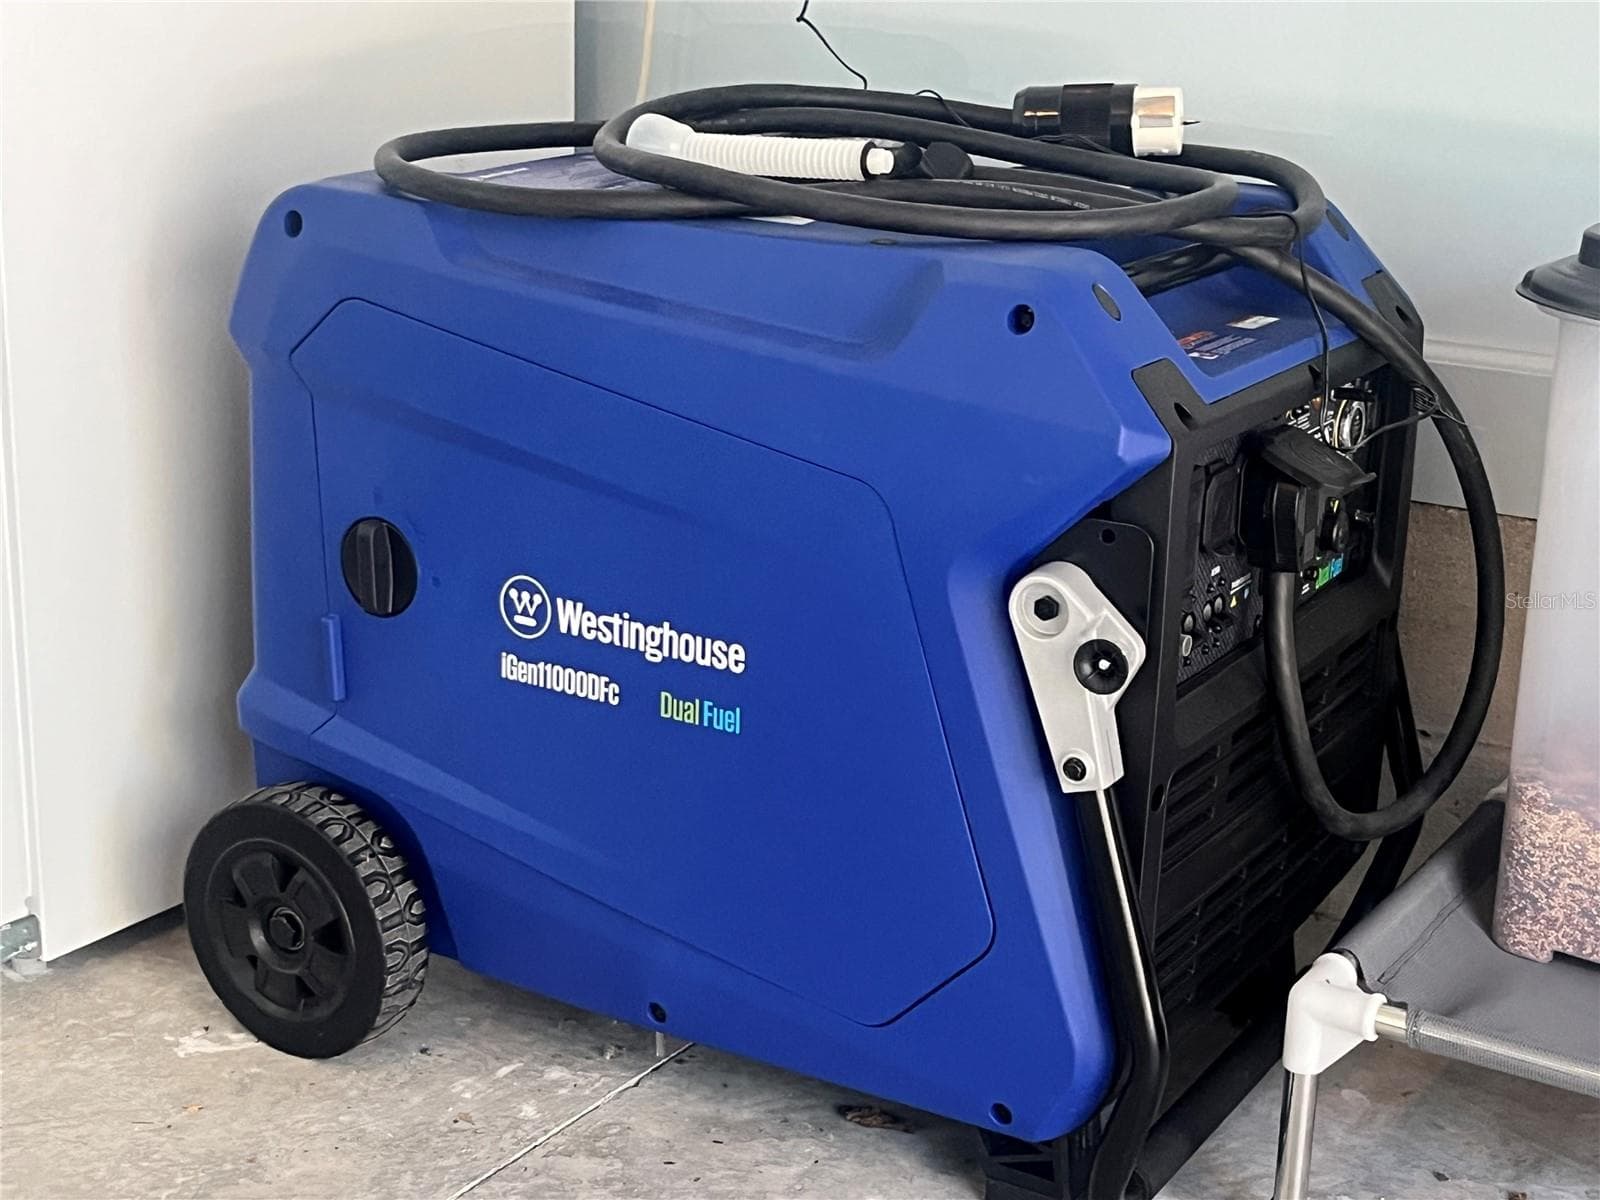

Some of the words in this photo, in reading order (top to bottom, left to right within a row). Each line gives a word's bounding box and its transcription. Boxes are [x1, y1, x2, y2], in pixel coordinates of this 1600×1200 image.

[557, 597, 746, 674] Westinghouse
[501, 652, 620, 706] iGen11000DFc
[660, 691, 699, 725] Dual
[703, 700, 740, 734] Fuel
